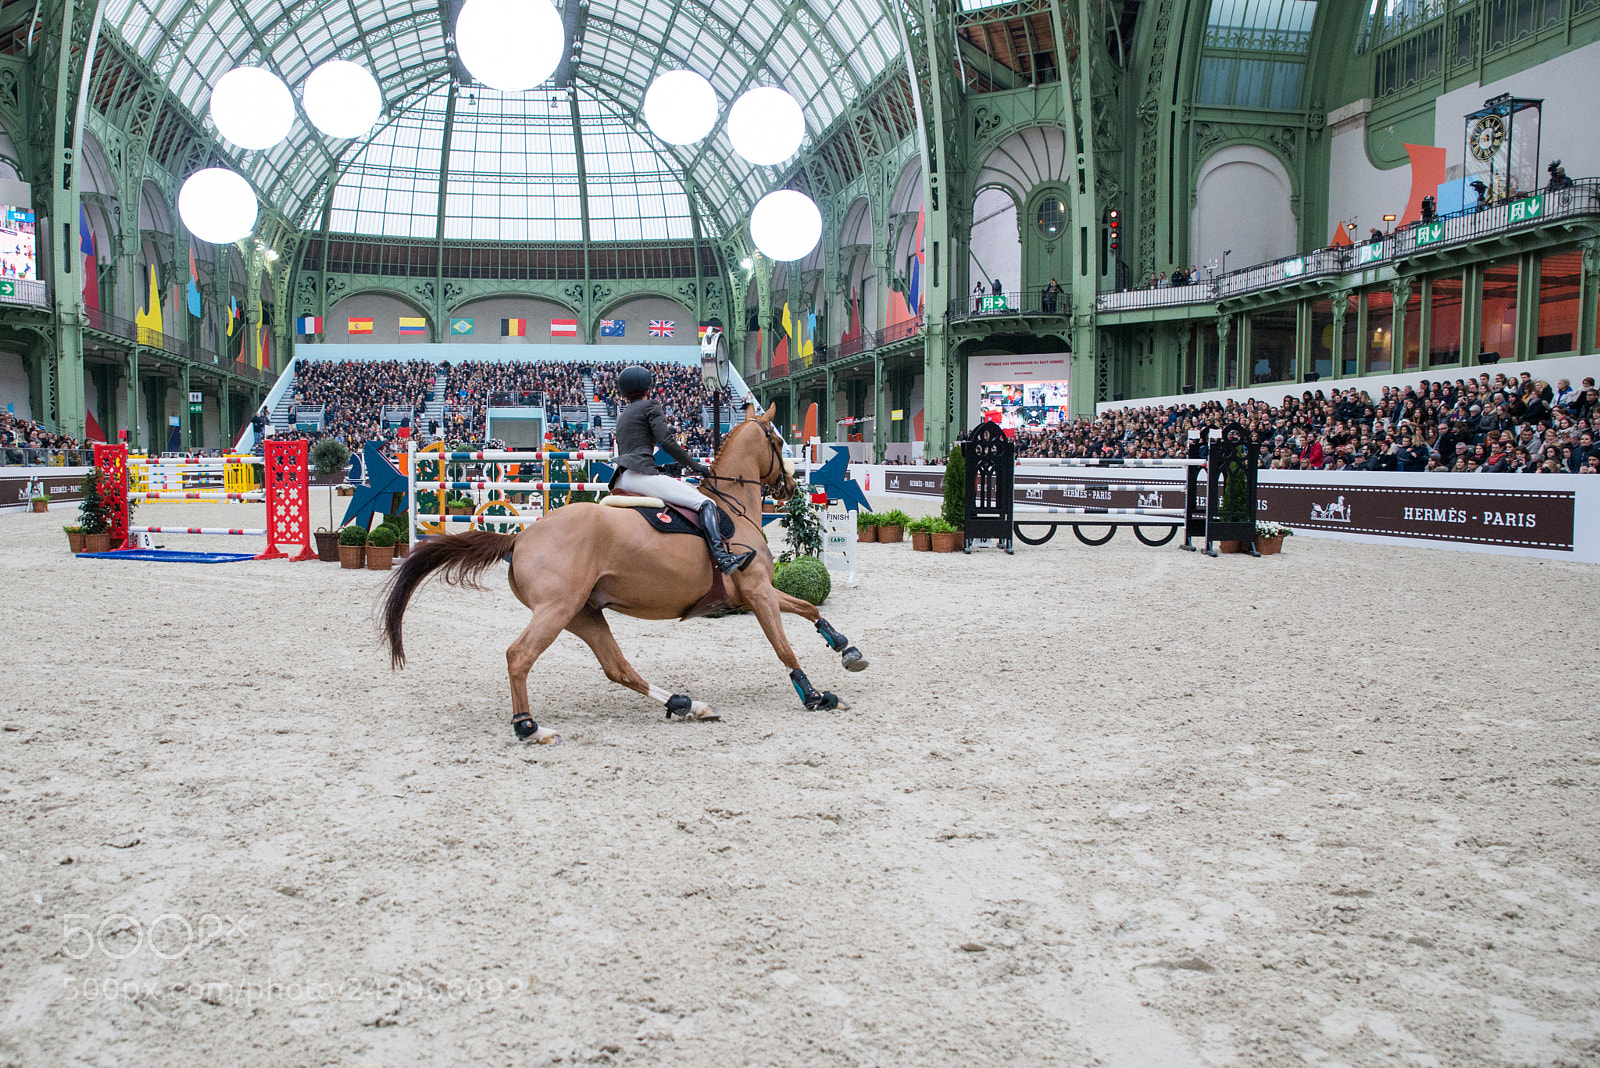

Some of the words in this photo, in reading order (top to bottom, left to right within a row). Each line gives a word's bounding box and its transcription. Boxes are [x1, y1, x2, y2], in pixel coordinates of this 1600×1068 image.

[1092, 490, 1112, 500] PARIS
[826, 513, 850, 521] FINISH
[1403, 507, 1467, 523] HERMÈS
[1483, 511, 1537, 528] PARIS
[144, 534, 150, 547] 8
